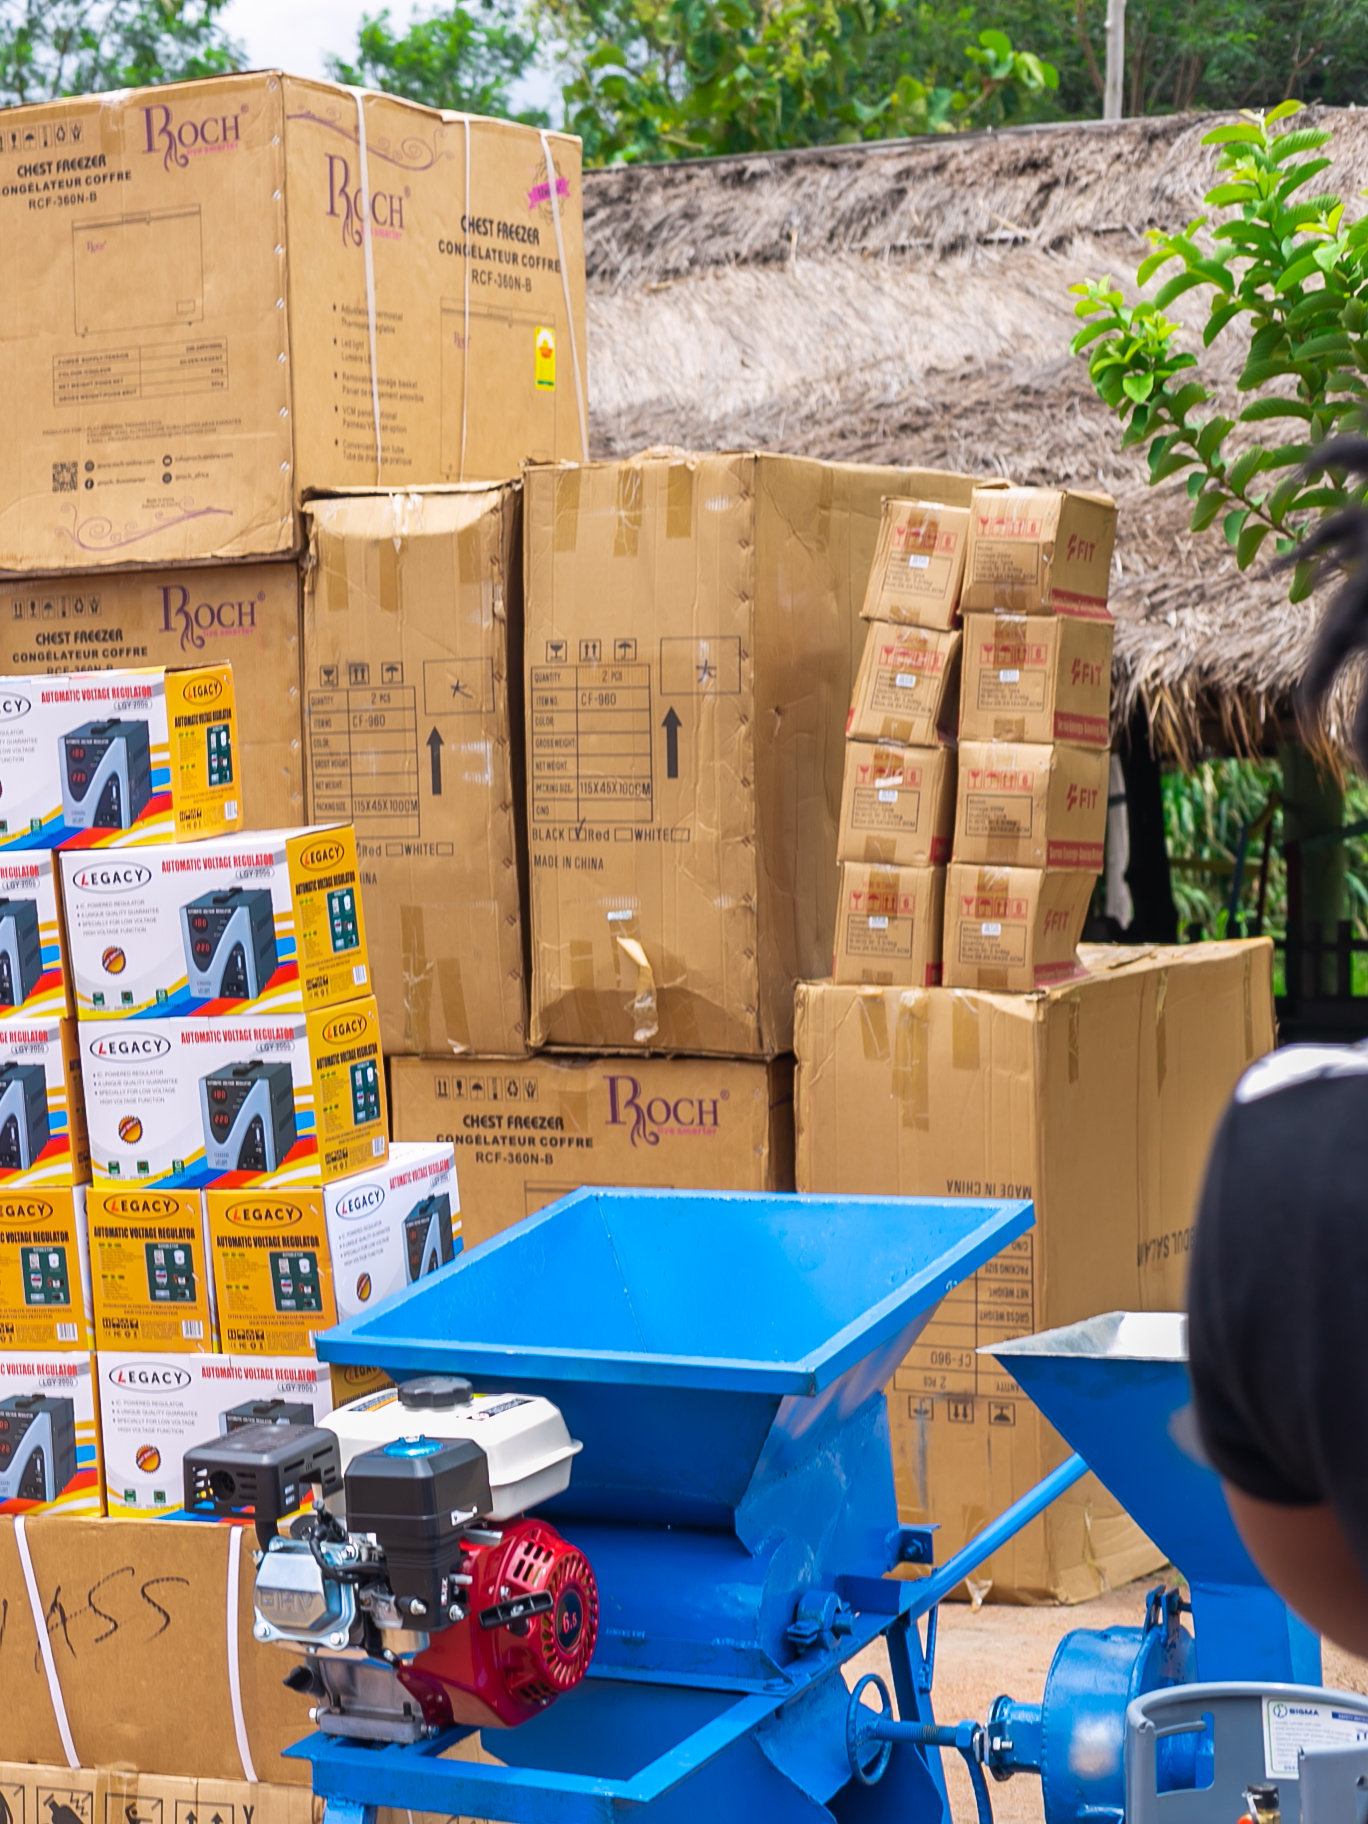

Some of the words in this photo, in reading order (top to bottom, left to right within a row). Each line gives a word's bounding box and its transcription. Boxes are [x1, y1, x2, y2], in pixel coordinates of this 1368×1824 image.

[140, 104, 240, 172] ROCH
[17, 160, 53, 178] CHEST
[56, 154, 107, 174] FREEZER
[85, 170, 132, 186] COFFRE
[461, 215, 494, 236] CHEST
[497, 222, 540, 246] FREEZER
[157, 584, 257, 651] ROCH
[35, 631, 70, 645] CHEST
[72, 628, 124, 643] FREEZER
[12, 649, 96, 664] CONGÉLATEUR
[99, 646, 148, 660] COFFRE
[186, 680, 219, 697] LEGACY
[581, 693, 617, 706] CF-960
[353, 715, 386, 728] CF-960
[532, 828, 565, 842] BLACK
[588, 828, 610, 842] Red
[634, 828, 671, 842] WHITE
[304, 847, 340, 866] LEGACY
[405, 843, 436, 856] WHITE
[533, 855, 559, 869] MADE
[563, 856, 573, 870] IN
[574, 857, 604, 871] CHINA
[81, 870, 144, 886] LEGACY
[326, 1020, 363, 1039] LEGACY
[98, 1039, 162, 1055] LEGACY
[603, 1075, 719, 1148] ROCH
[462, 1114, 503, 1129] CHEST
[506, 1115, 564, 1131] FREEZER
[436, 1133, 537, 1148] CONGÉLATEUR
[540, 1136, 593, 1148] COFFRE
[475, 1152, 554, 1166] RCF-360N-B
[946, 1180, 982, 1196] CHINA
[986, 1183, 997, 1197] IN
[1000, 1184, 1032, 1199] MADE
[110, 1201, 171, 1213] LEGACY
[341, 1190, 381, 1214] LEGACY
[233, 1208, 295, 1222] LEGACY
[930, 1350, 972, 1368] CF-960
[118, 1372, 182, 1386] LEGACY
[560, 1609, 579, 1632] 6.5
